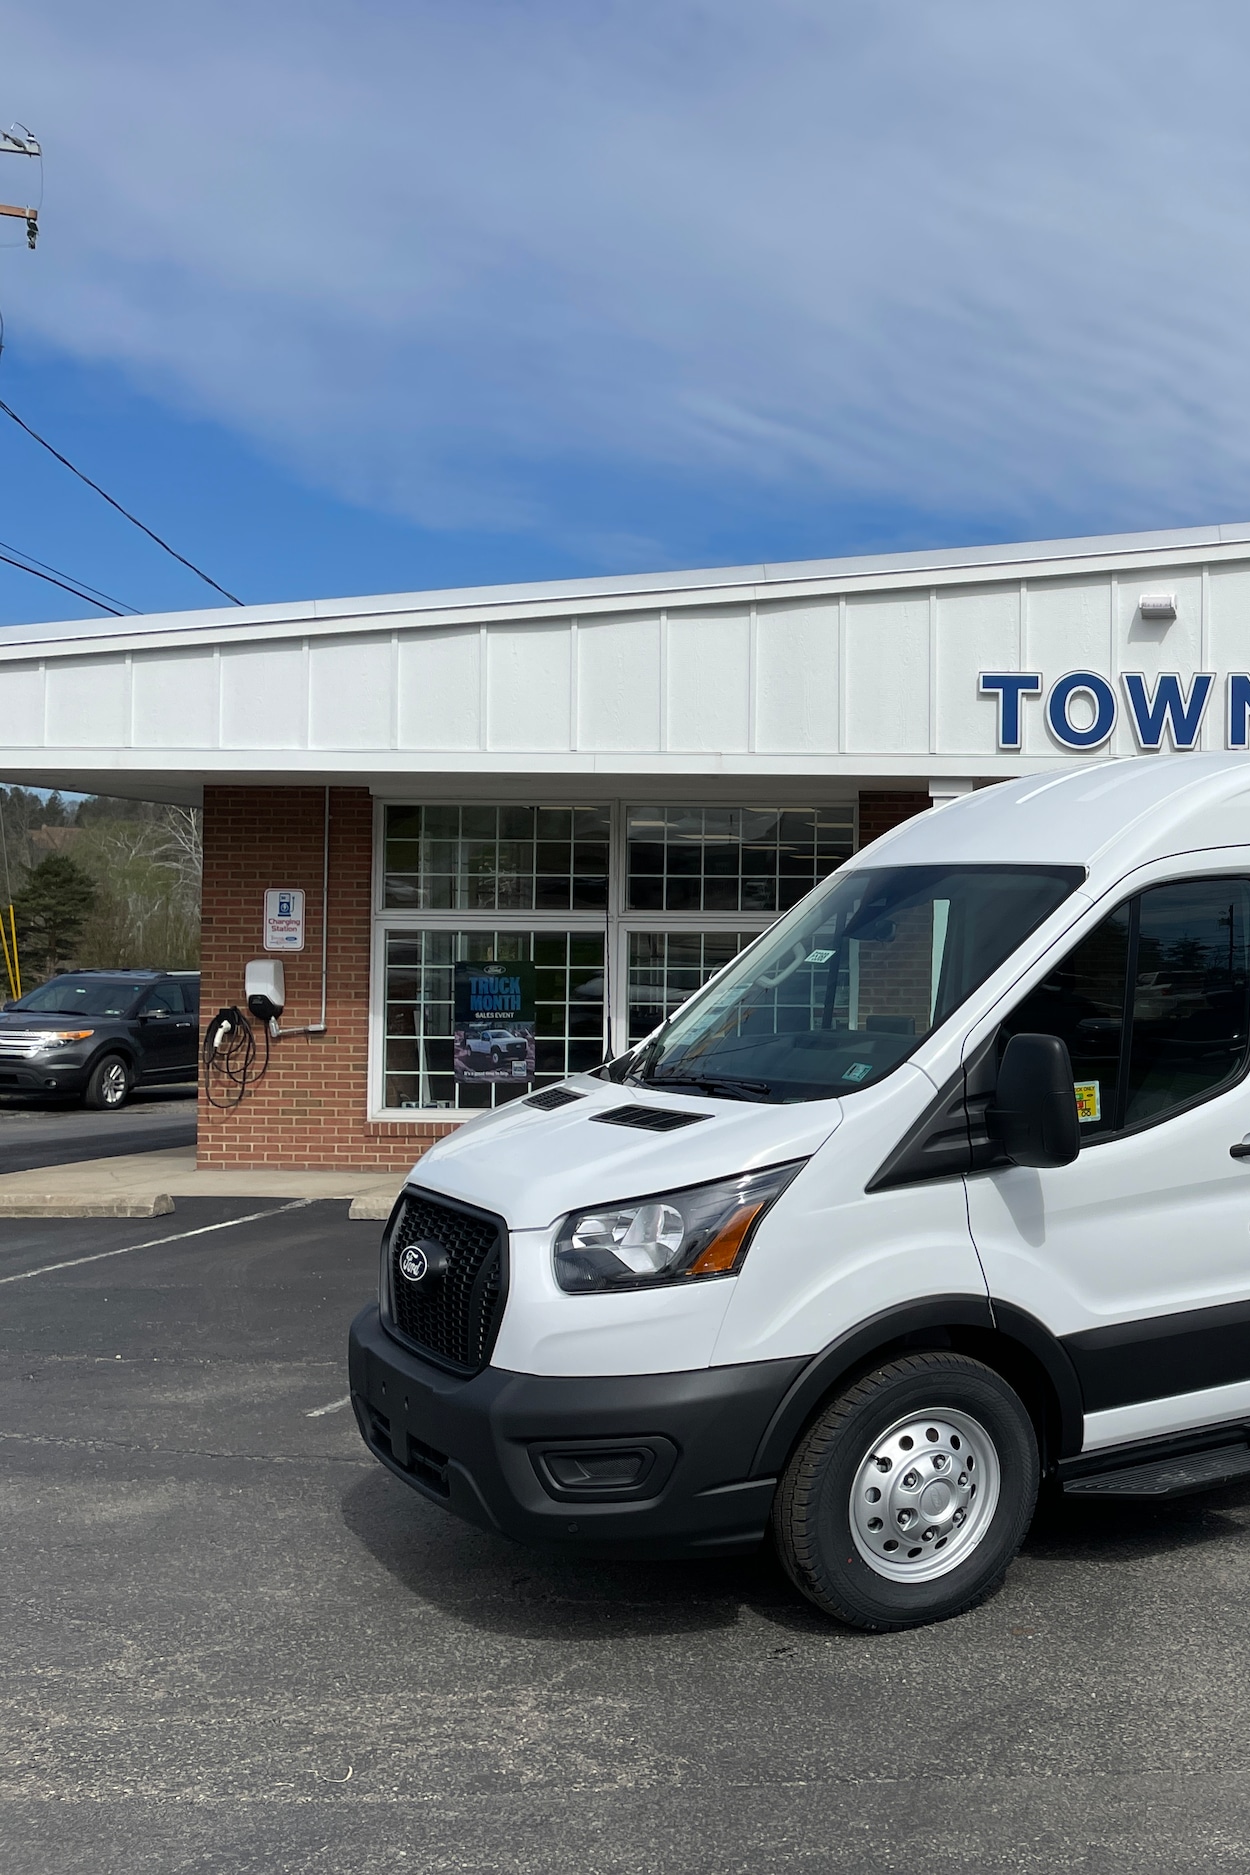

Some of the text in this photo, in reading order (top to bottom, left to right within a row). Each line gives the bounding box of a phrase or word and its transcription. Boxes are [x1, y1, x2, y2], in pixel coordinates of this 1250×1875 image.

[268, 918, 300, 926] Charging
[469, 976, 520, 994] TRUCK
[470, 995, 521, 1011] MONTH
[403, 1250, 423, 1276] Ford
